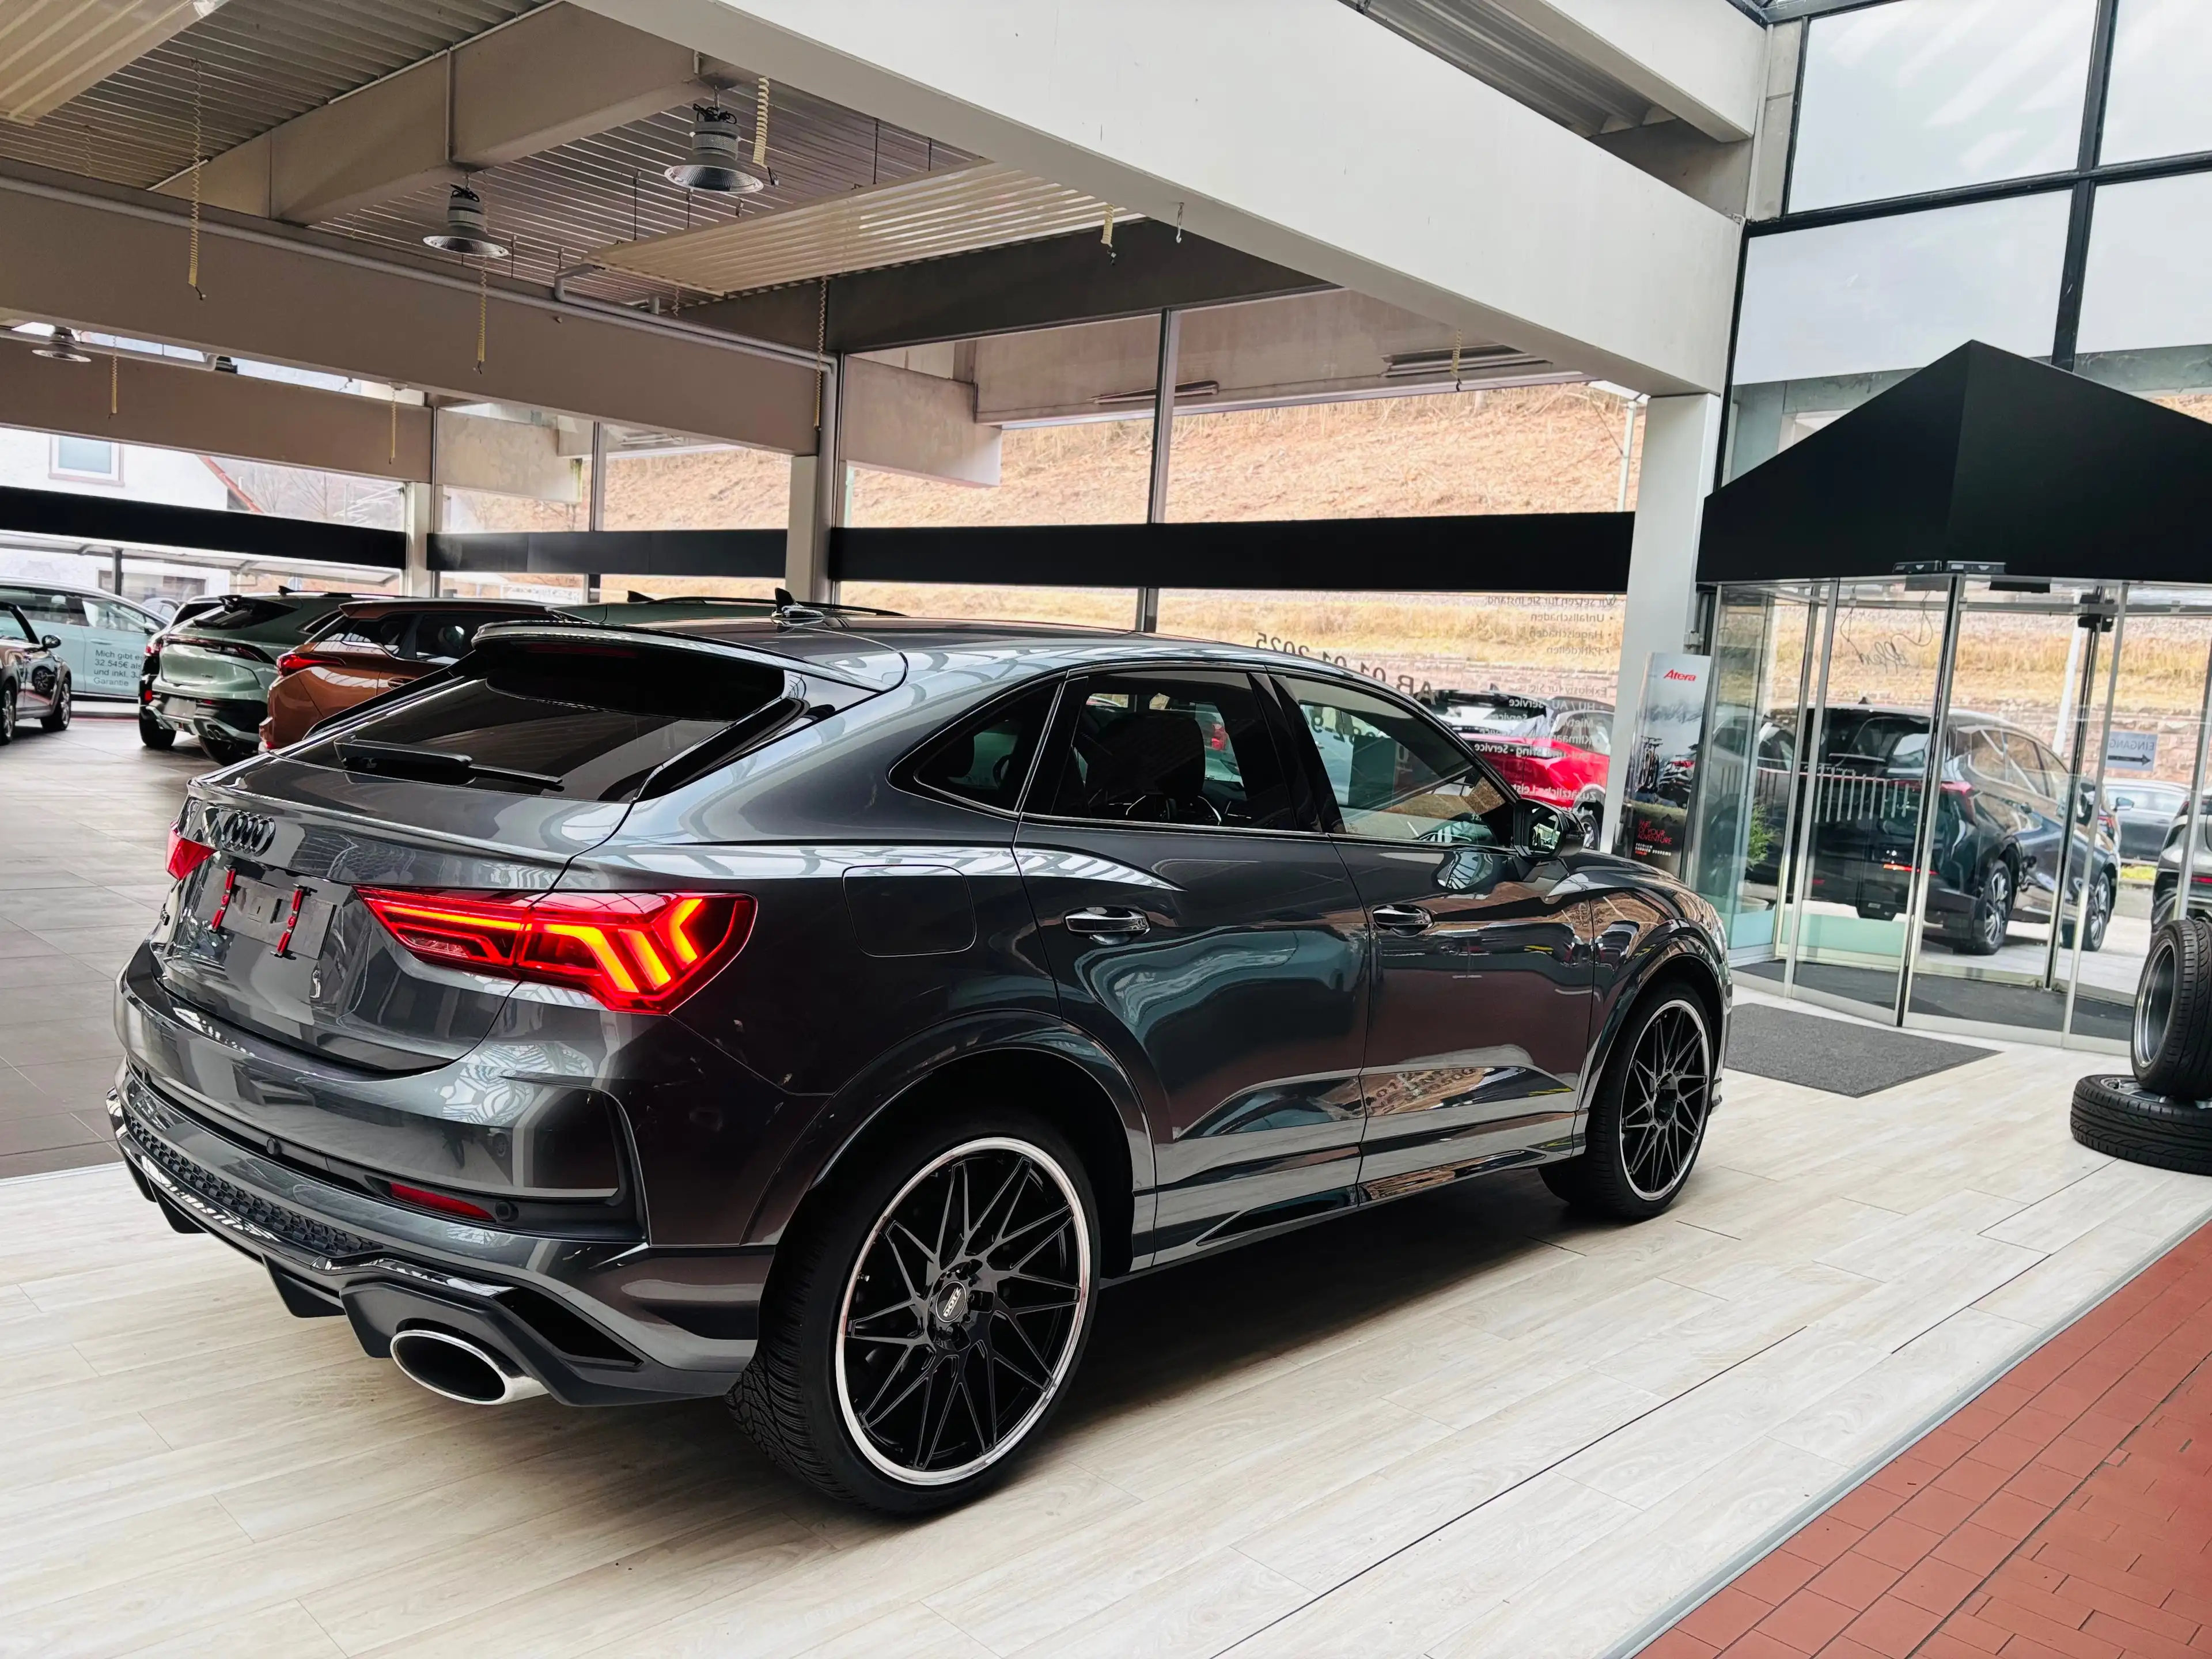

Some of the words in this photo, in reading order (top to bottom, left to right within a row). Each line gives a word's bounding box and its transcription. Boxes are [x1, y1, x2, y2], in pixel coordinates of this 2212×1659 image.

[95, 649, 115, 658] Mich
[1663, 668, 1696, 682] Atera
[93, 677, 130, 687] Garantie
[1647, 828, 1666, 838] YOUR
[1638, 833, 1673, 845] ADVENTURE
[943, 1287, 961, 1317] DOTZ
